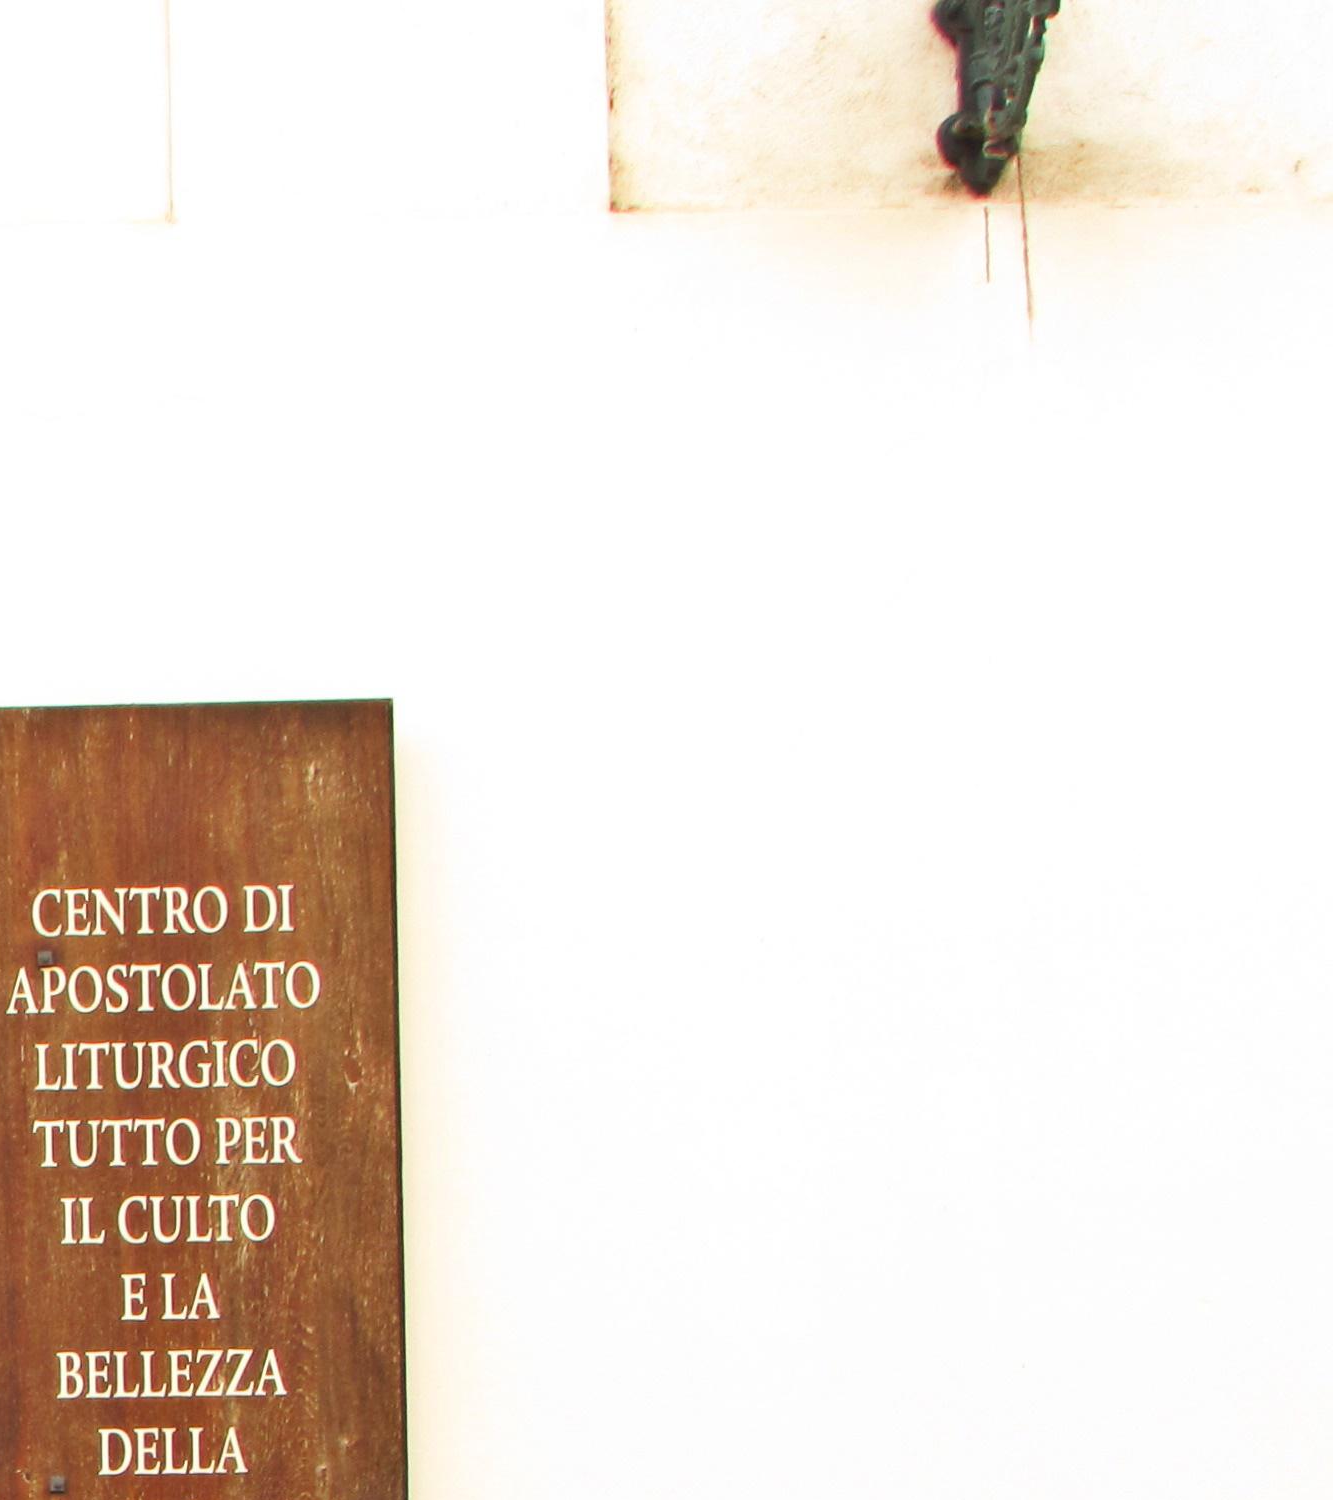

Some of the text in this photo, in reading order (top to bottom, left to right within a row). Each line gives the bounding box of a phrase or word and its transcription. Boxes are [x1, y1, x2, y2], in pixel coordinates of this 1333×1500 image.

[32, 884, 294, 937] CENTRO DI
[6, 961, 321, 1015] APOSTOLATO
[34, 1039, 296, 1091] LITURGICO
[32, 1116, 303, 1168] TUTTO PER
[60, 1194, 275, 1244] IL CULTO
[121, 1273, 221, 1321] E LA
[56, 1348, 288, 1399] BELLEZZA
[98, 1427, 248, 1476] DELLA
